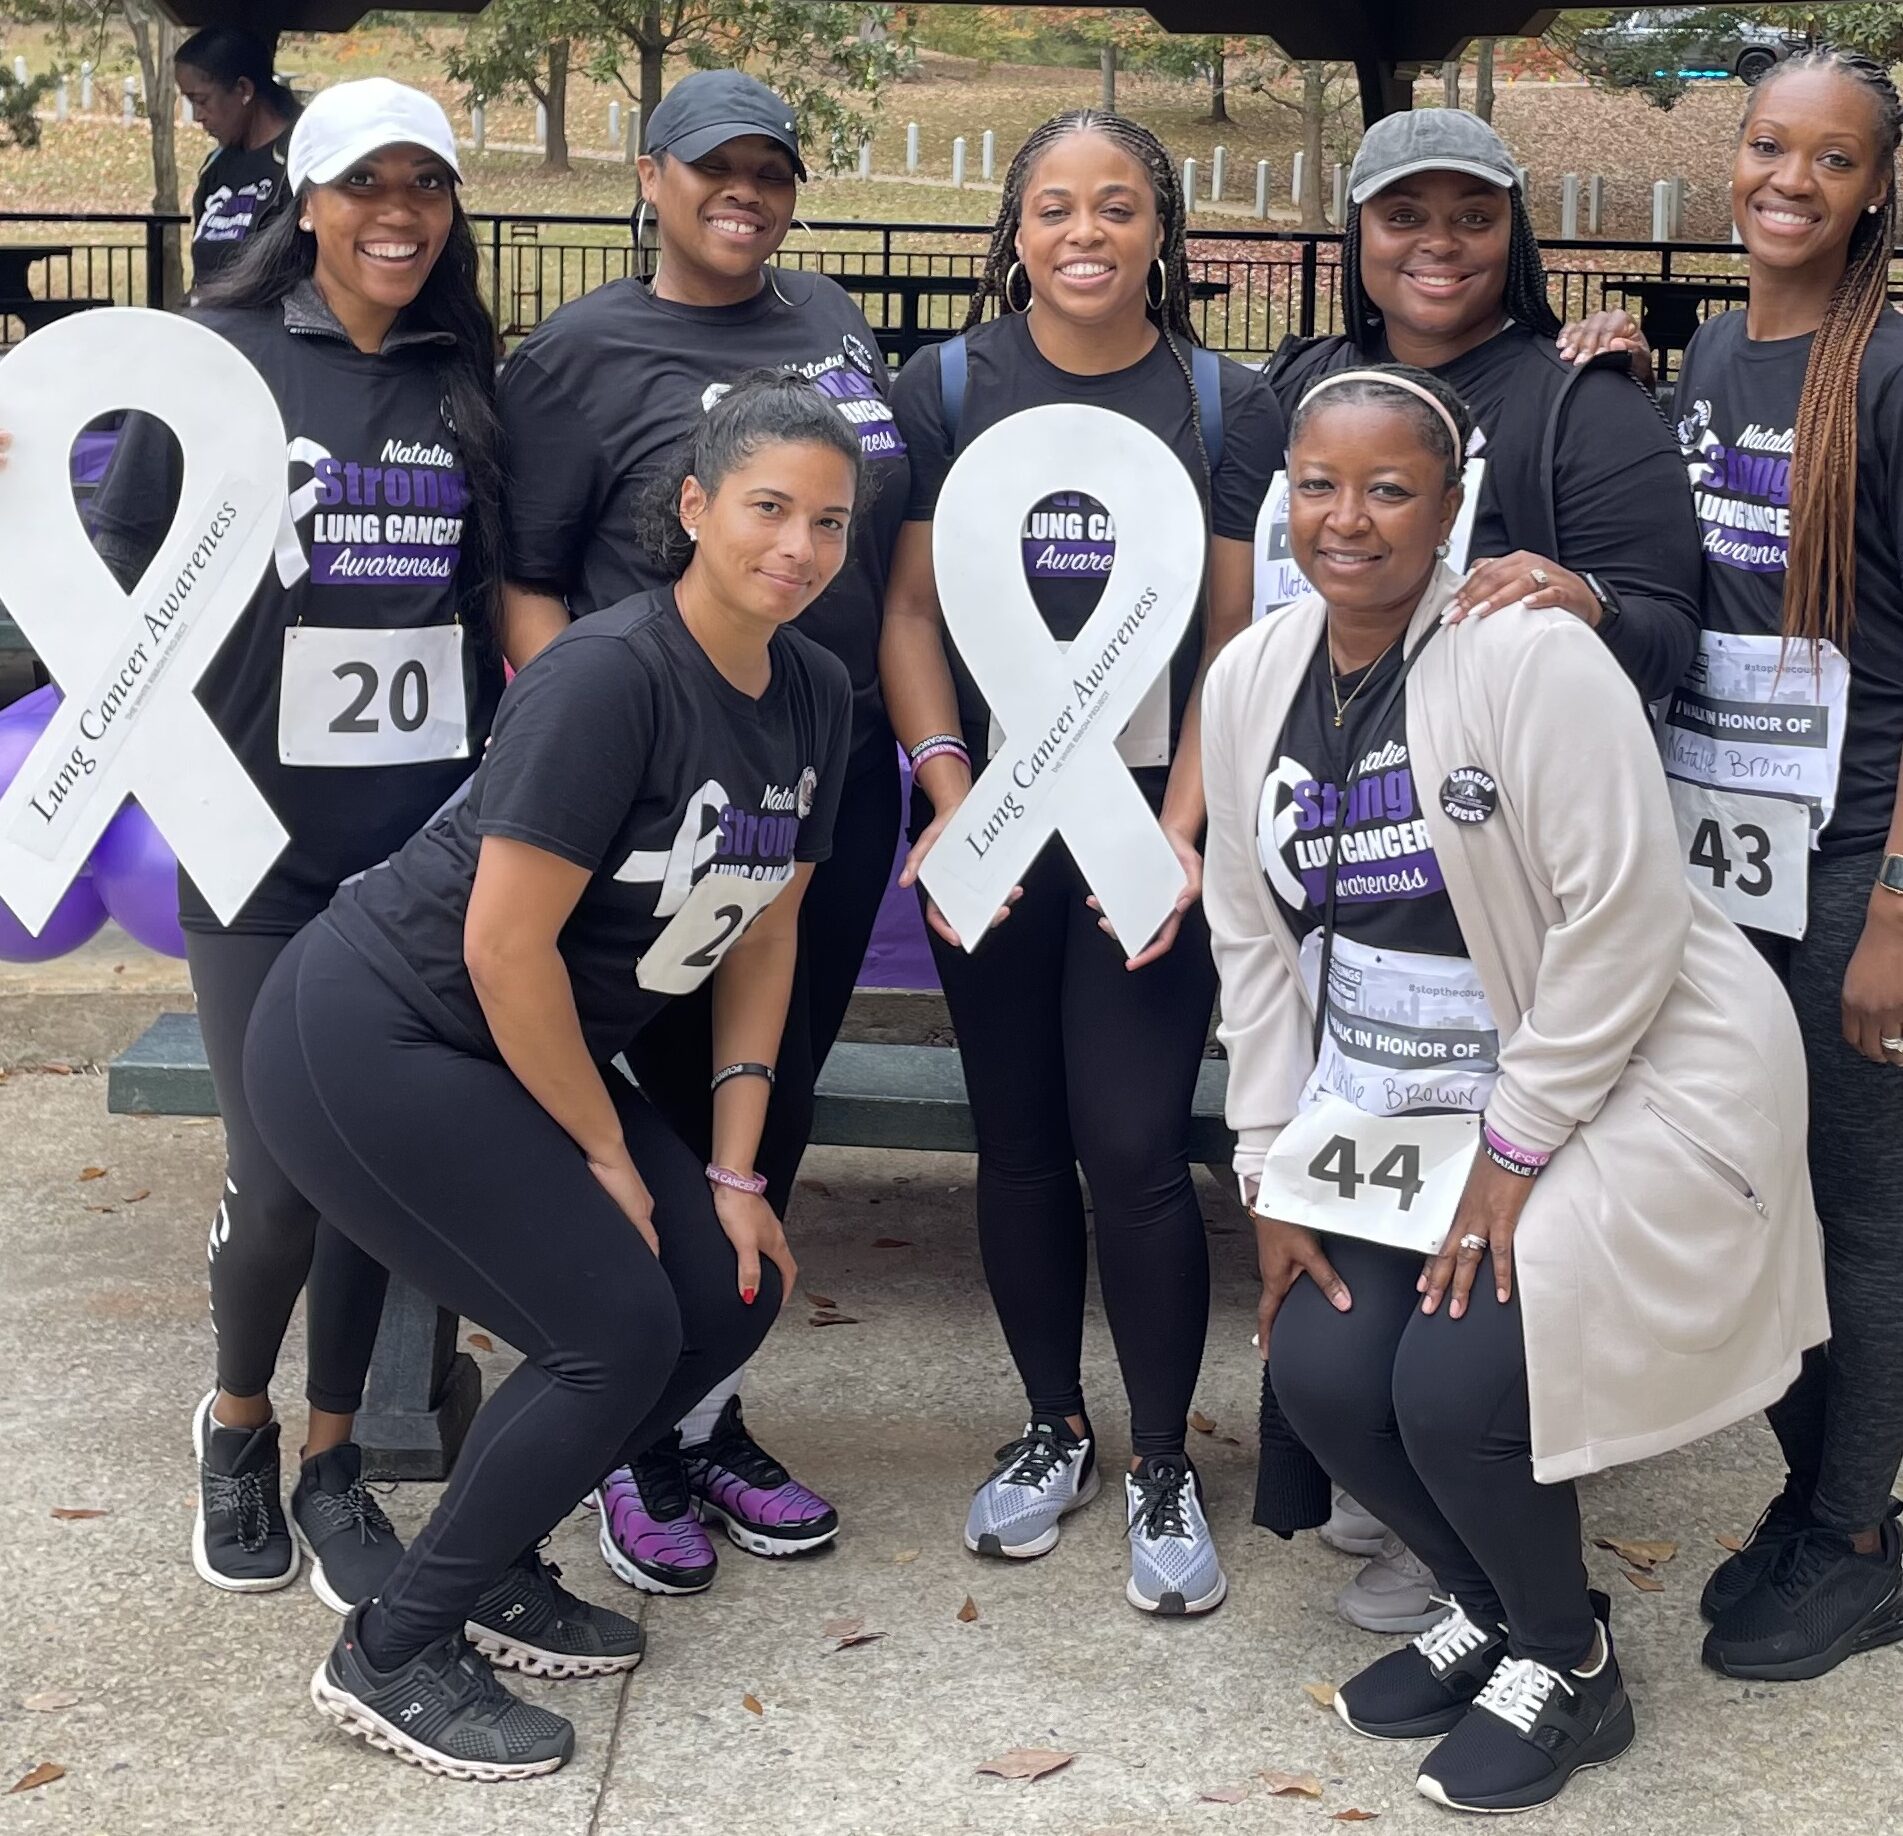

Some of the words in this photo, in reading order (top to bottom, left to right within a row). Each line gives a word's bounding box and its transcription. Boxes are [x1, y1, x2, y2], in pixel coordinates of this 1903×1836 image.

[381, 439, 453, 468] Natalie
[314, 514, 380, 543] LUNG
[329, 548, 451, 577] Awareness
[1036, 544, 1114, 571] Aware
[28, 745, 96, 824] Lung
[80, 643, 150, 740] Cancer
[143, 501, 237, 646] Awareness
[329, 660, 429, 733] 20
[964, 791, 1024, 860] Lung
[1012, 704, 1075, 789] Cancer
[1072, 586, 1158, 709] Awareness
[1718, 712, 1782, 732] HONOR
[1786, 717, 1812, 733] OF
[1725, 750, 1801, 780] Brown
[1450, 770, 1495, 792] CANCER
[1445, 802, 1484, 821] SUCKS
[1340, 819, 1433, 864] CANCER
[1689, 818, 1773, 897] 43
[1336, 867, 1428, 896] wareness
[681, 904, 770, 966] 2
[1408, 983, 1485, 1000] #stopthecoug
[1355, 1029, 1372, 1048] IN
[1376, 1033, 1447, 1058] HONOR
[1452, 1043, 1480, 1058] OF
[1308, 1134, 1425, 1212] 44
[1491, 1152, 1532, 1177] NATALIE
